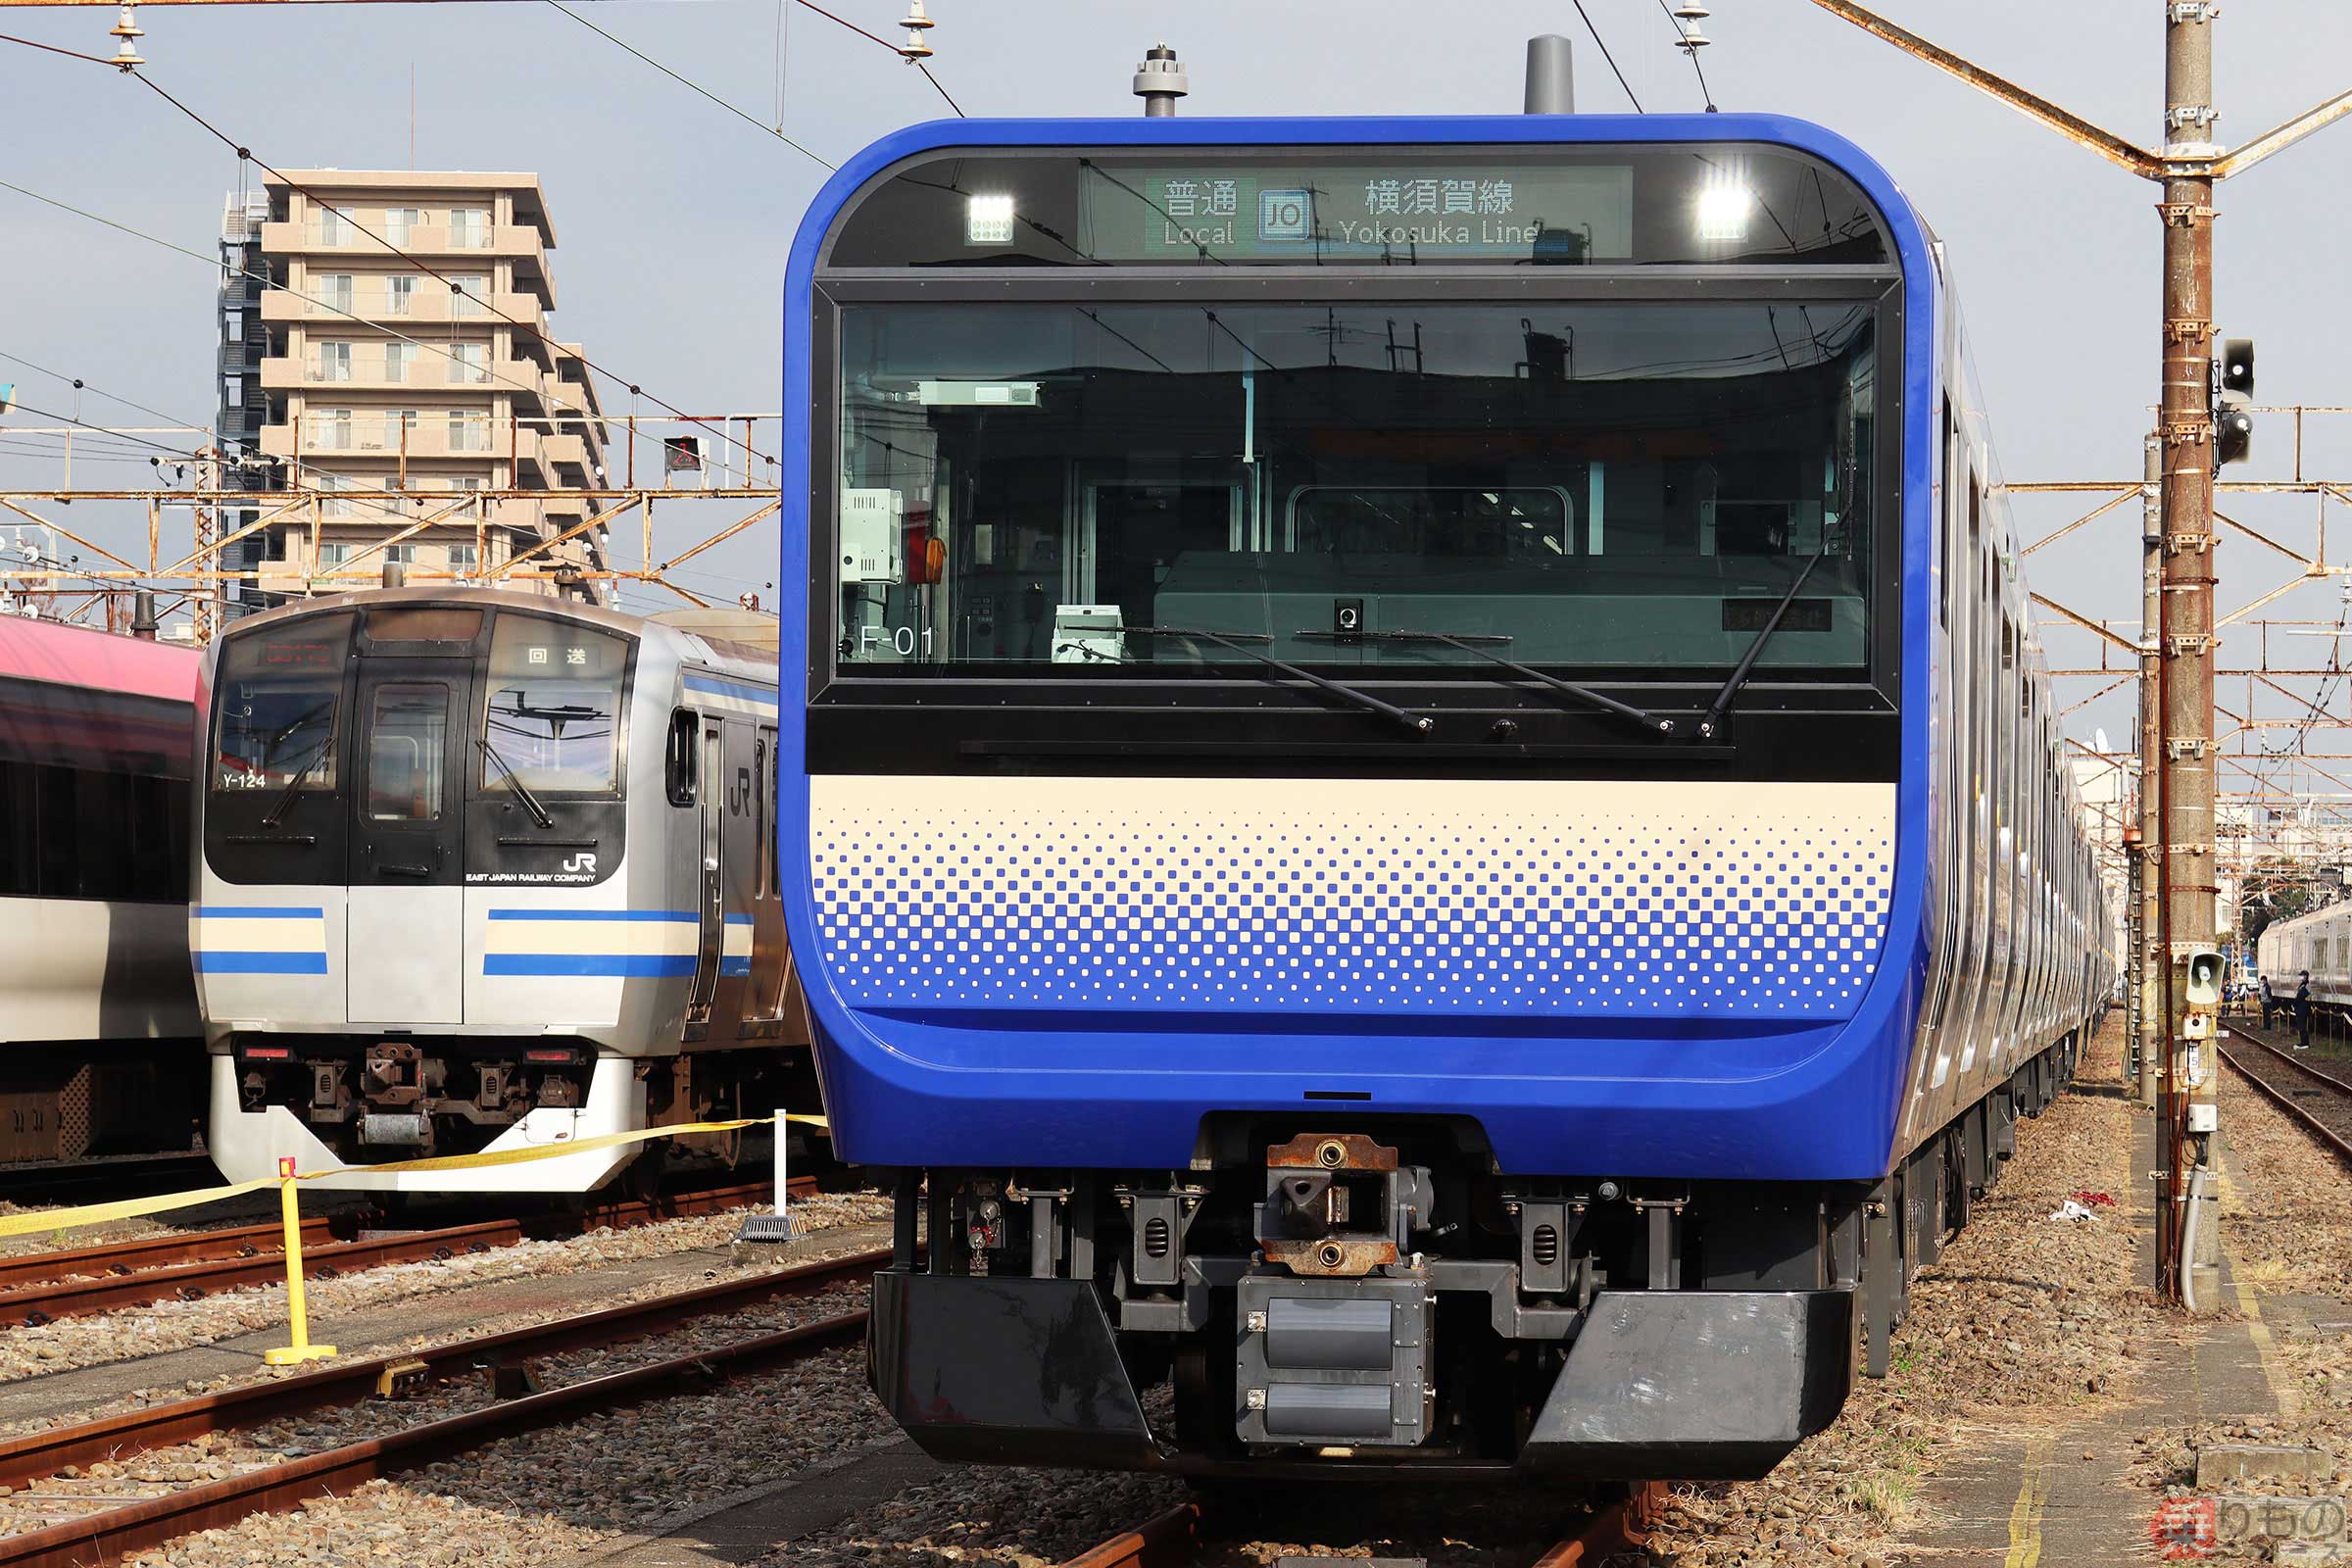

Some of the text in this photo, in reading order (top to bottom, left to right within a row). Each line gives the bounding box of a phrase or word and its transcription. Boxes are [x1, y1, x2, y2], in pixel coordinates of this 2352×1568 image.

[1164, 180, 1237, 217] 普通
[1365, 179, 1514, 215] 横須賀線
[1267, 203, 1300, 226] JO
[1164, 220, 1235, 244] Local
[1338, 220, 1539, 244] Yokosuka Line
[529, 648, 586, 664] 回送
[223, 774, 266, 788] Y-124
[730, 767, 751, 817] JR
[564, 853, 596, 872] JR
[554, 874, 596, 883] COMPANY
